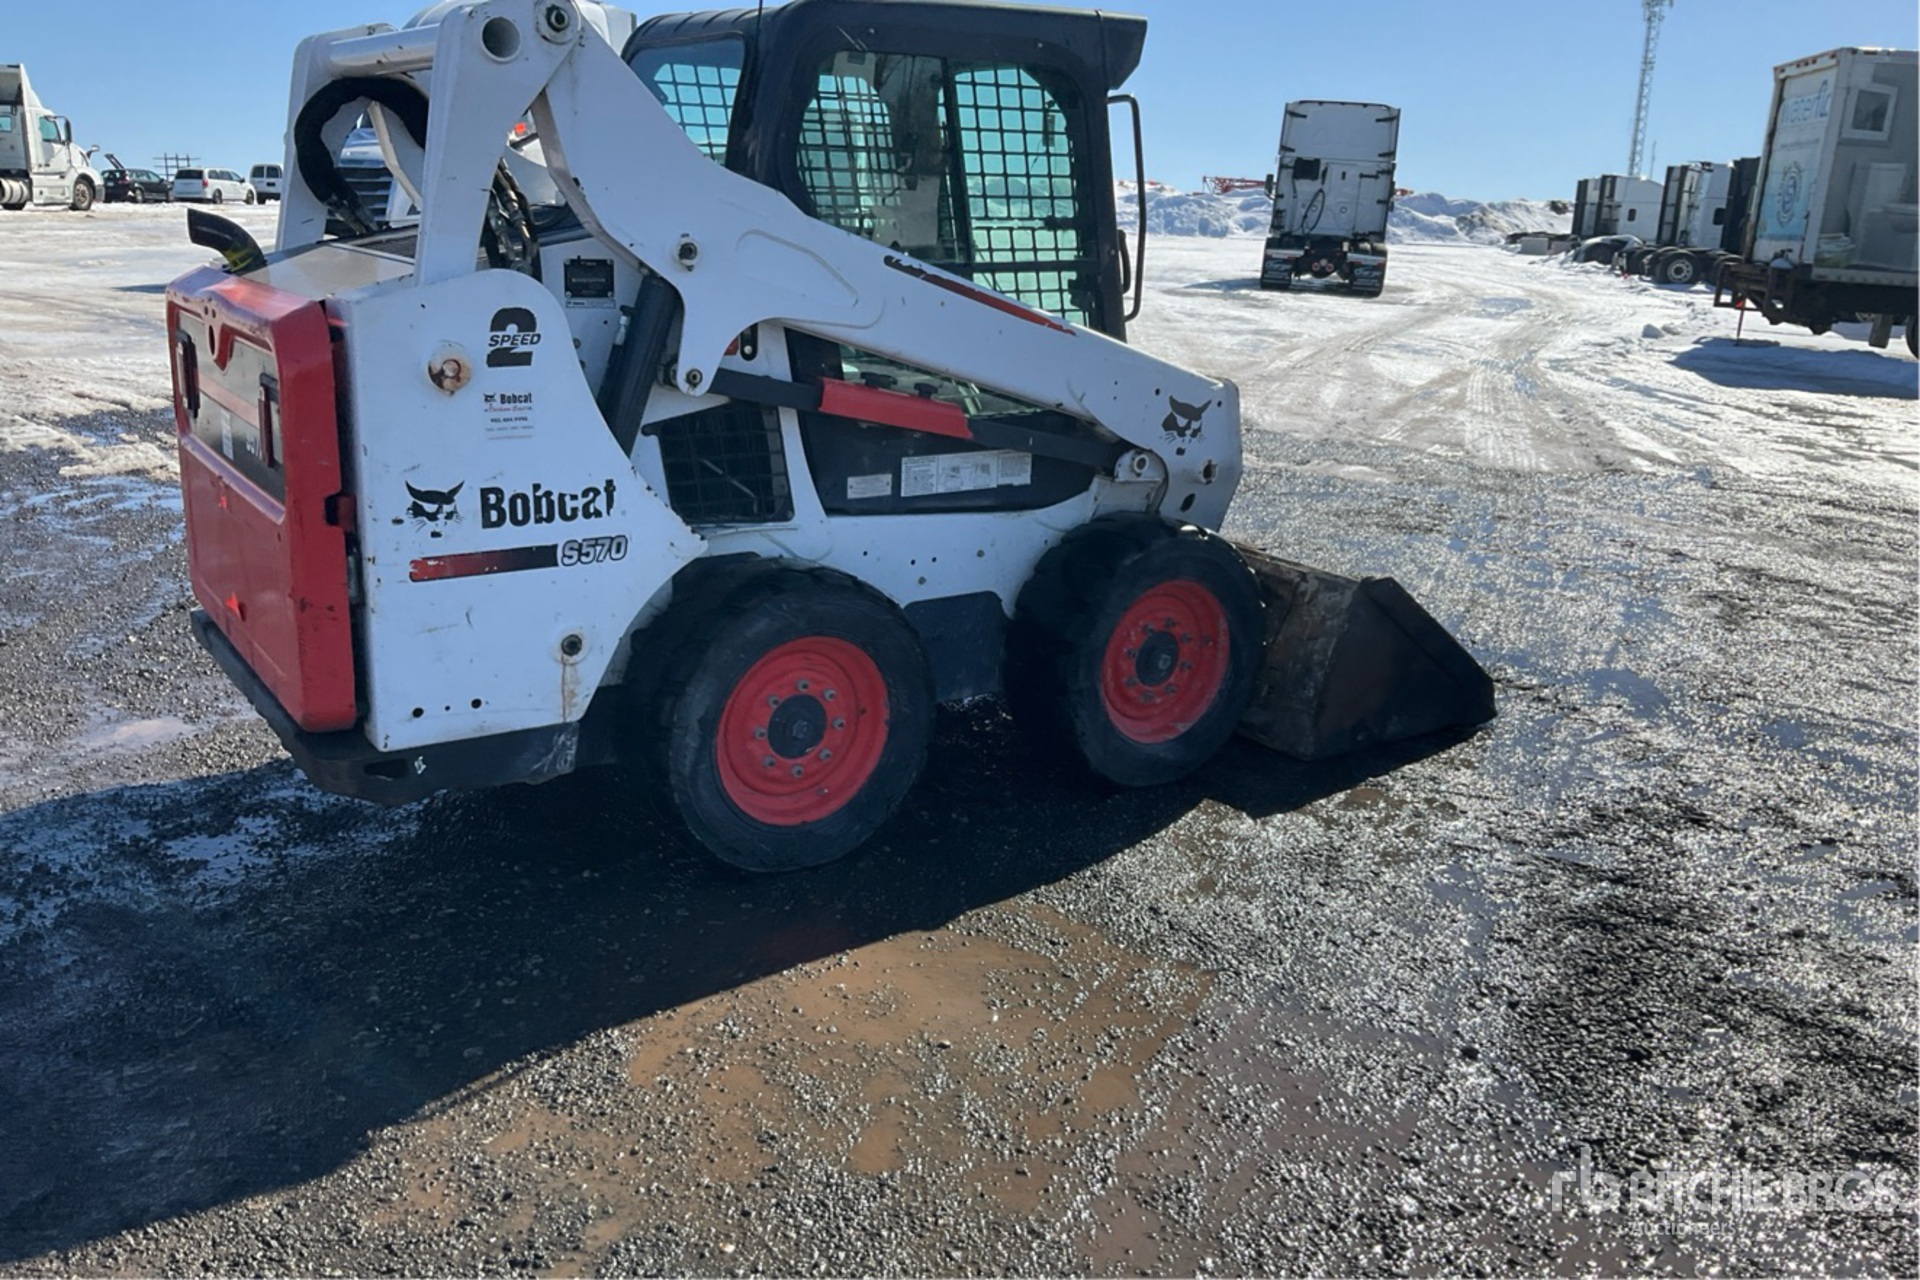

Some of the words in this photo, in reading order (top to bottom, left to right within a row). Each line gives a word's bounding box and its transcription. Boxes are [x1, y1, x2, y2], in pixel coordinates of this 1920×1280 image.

[486, 307, 537, 367] 2
[488, 333, 541, 347] SPEED
[500, 392, 532, 404] Bobcat
[480, 479, 616, 529] Bobcat
[561, 535, 628, 566] S570
